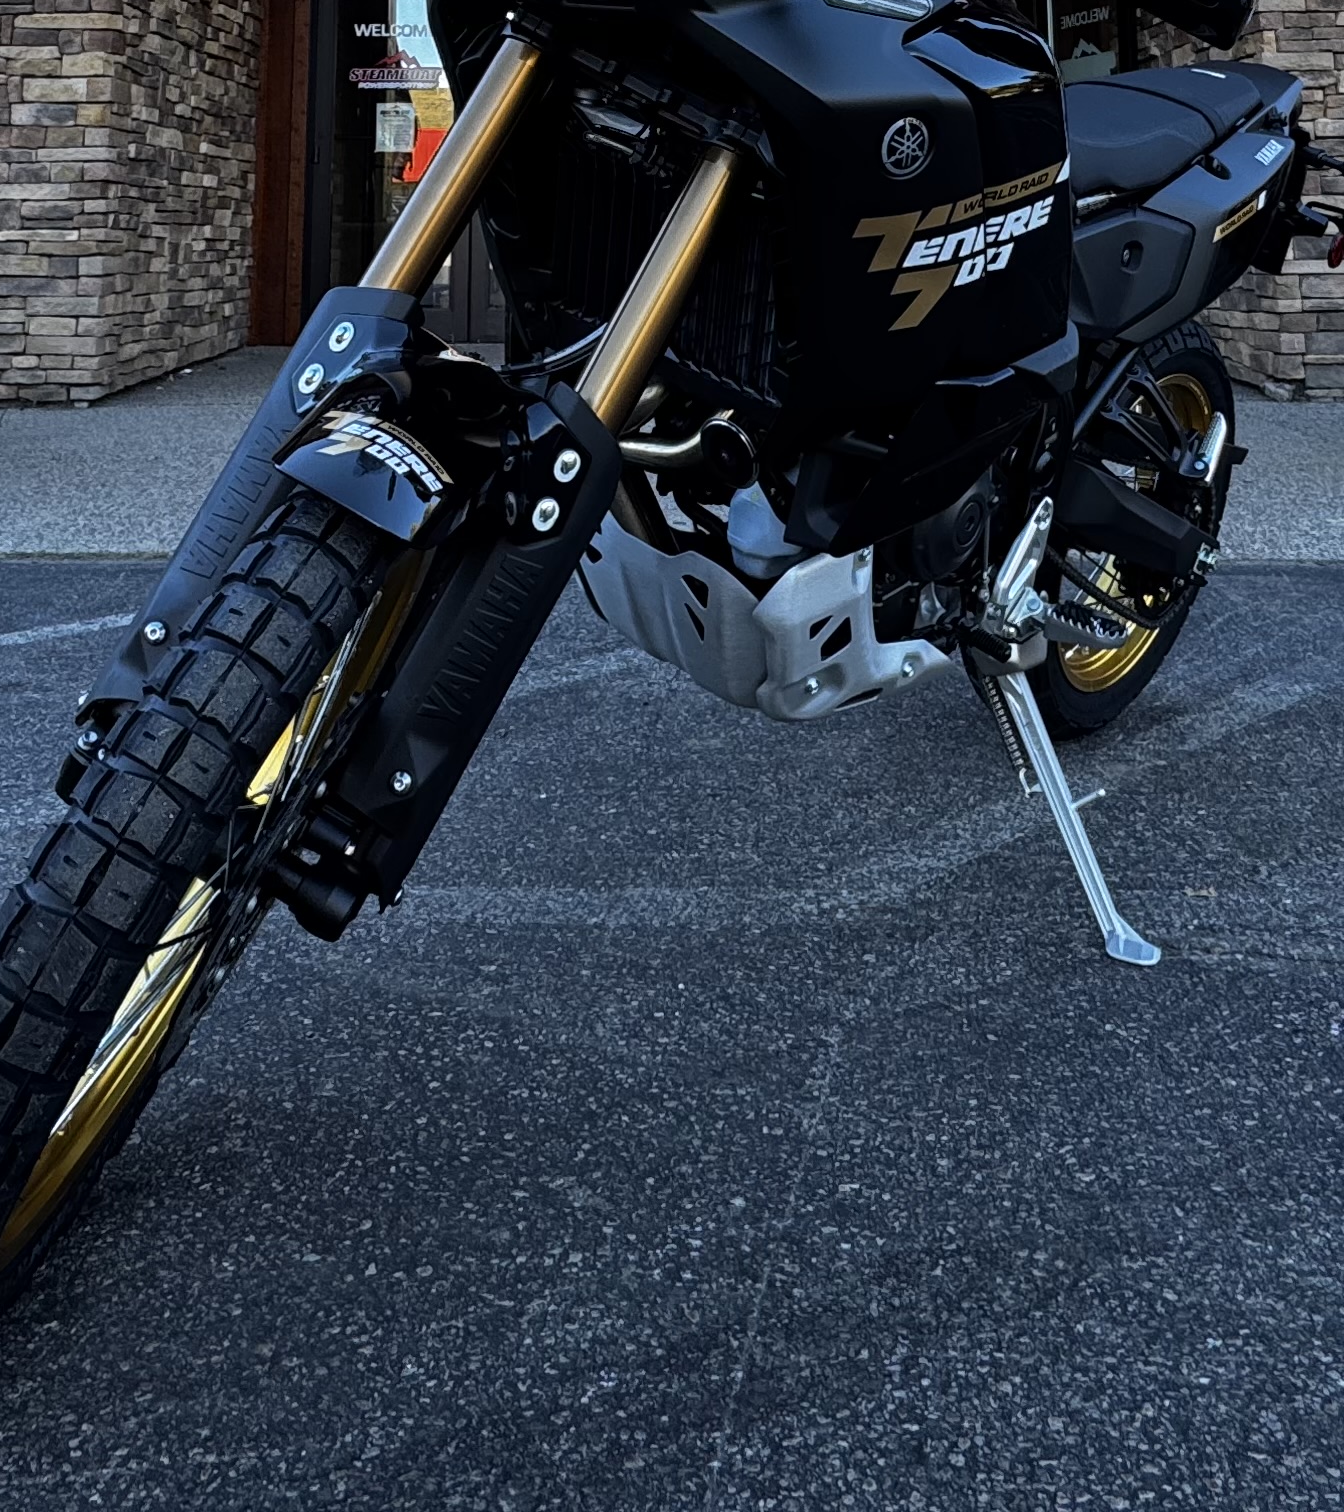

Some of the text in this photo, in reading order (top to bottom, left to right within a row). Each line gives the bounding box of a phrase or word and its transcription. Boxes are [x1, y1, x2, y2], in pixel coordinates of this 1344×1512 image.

[349, 68, 443, 82] STEAMBOAT
[1018, 172, 1049, 193] RAID
[888, 241, 1014, 332] 700
[316, 432, 411, 475] 700
[416, 553, 545, 724] YAMAHA
